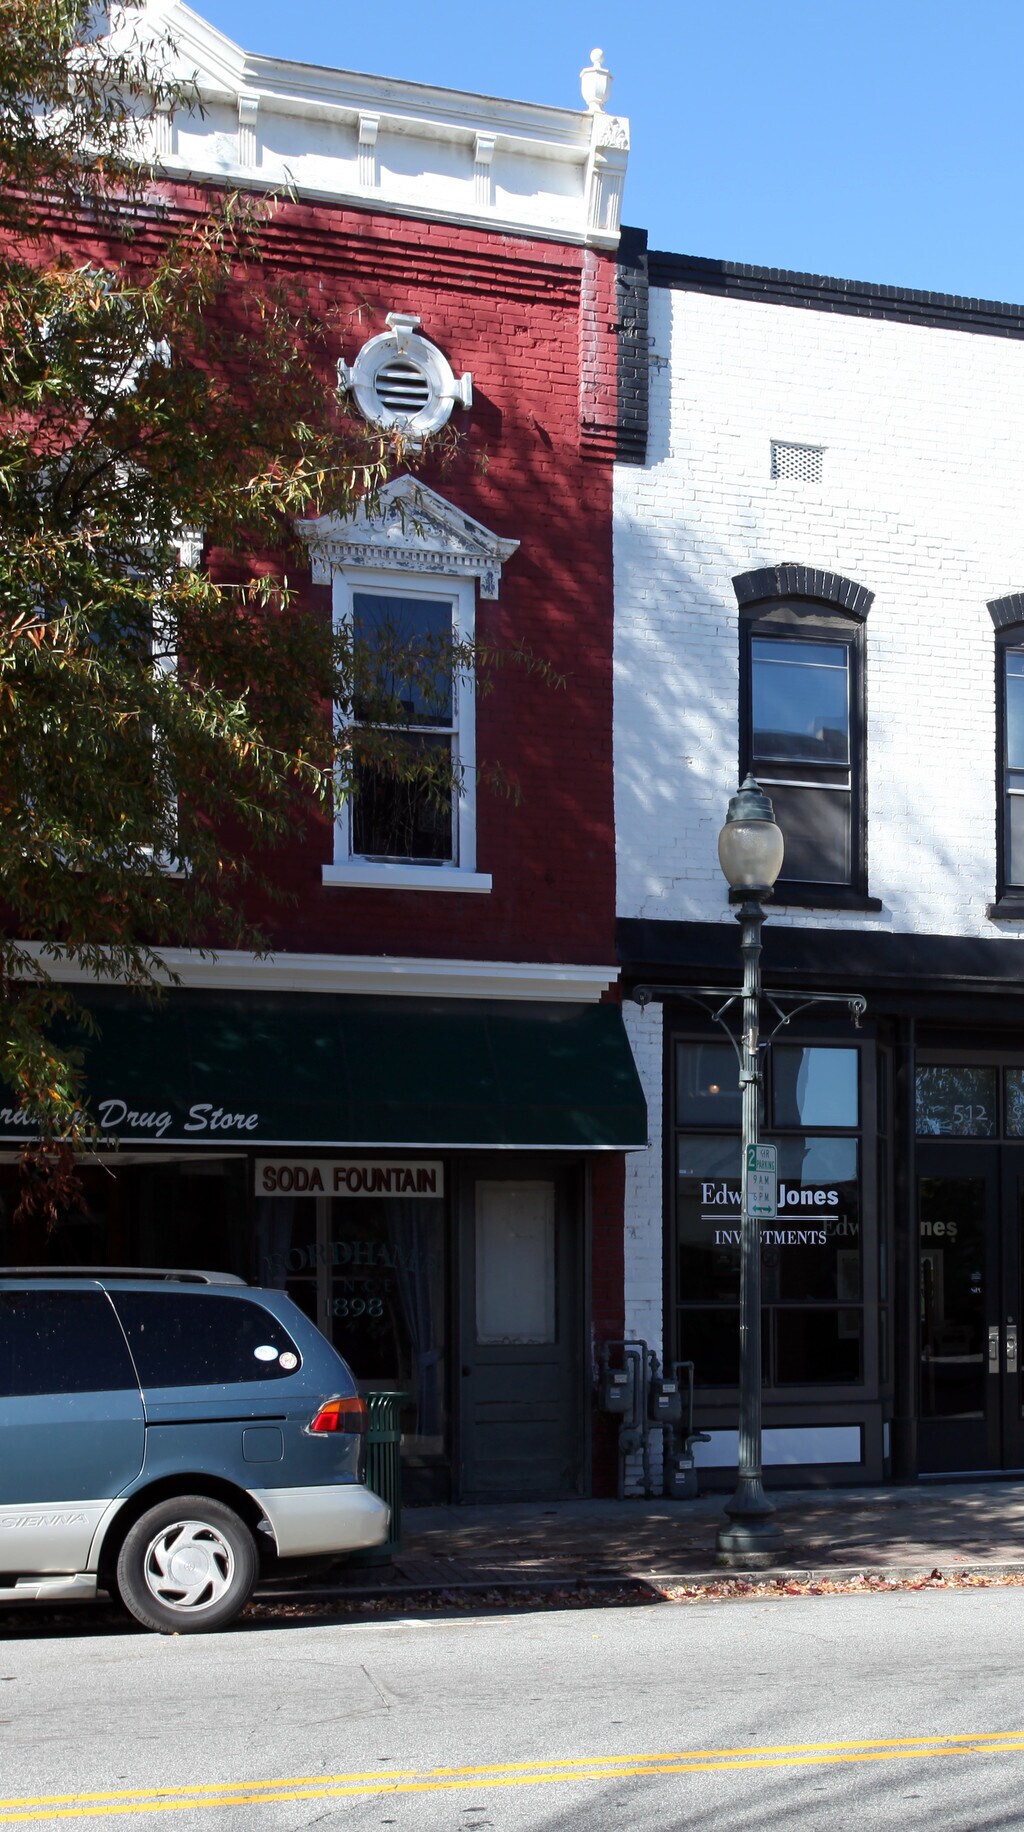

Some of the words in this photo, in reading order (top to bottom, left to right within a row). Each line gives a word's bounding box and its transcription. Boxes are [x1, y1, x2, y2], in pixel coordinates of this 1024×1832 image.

[99, 1100, 173, 1138] Drug
[184, 1103, 259, 1131] Store
[953, 1105, 988, 1124] 512
[748, 1149, 755, 1168] 2
[756, 1160, 775, 1170] PARKING
[263, 1166, 324, 1192] SODA
[333, 1167, 437, 1193] FOUNTAIN
[715, 1230, 827, 1245] INVSTMENTS
[325, 1298, 384, 1318] 1898
[0, 1513, 89, 1528] SIENNA
